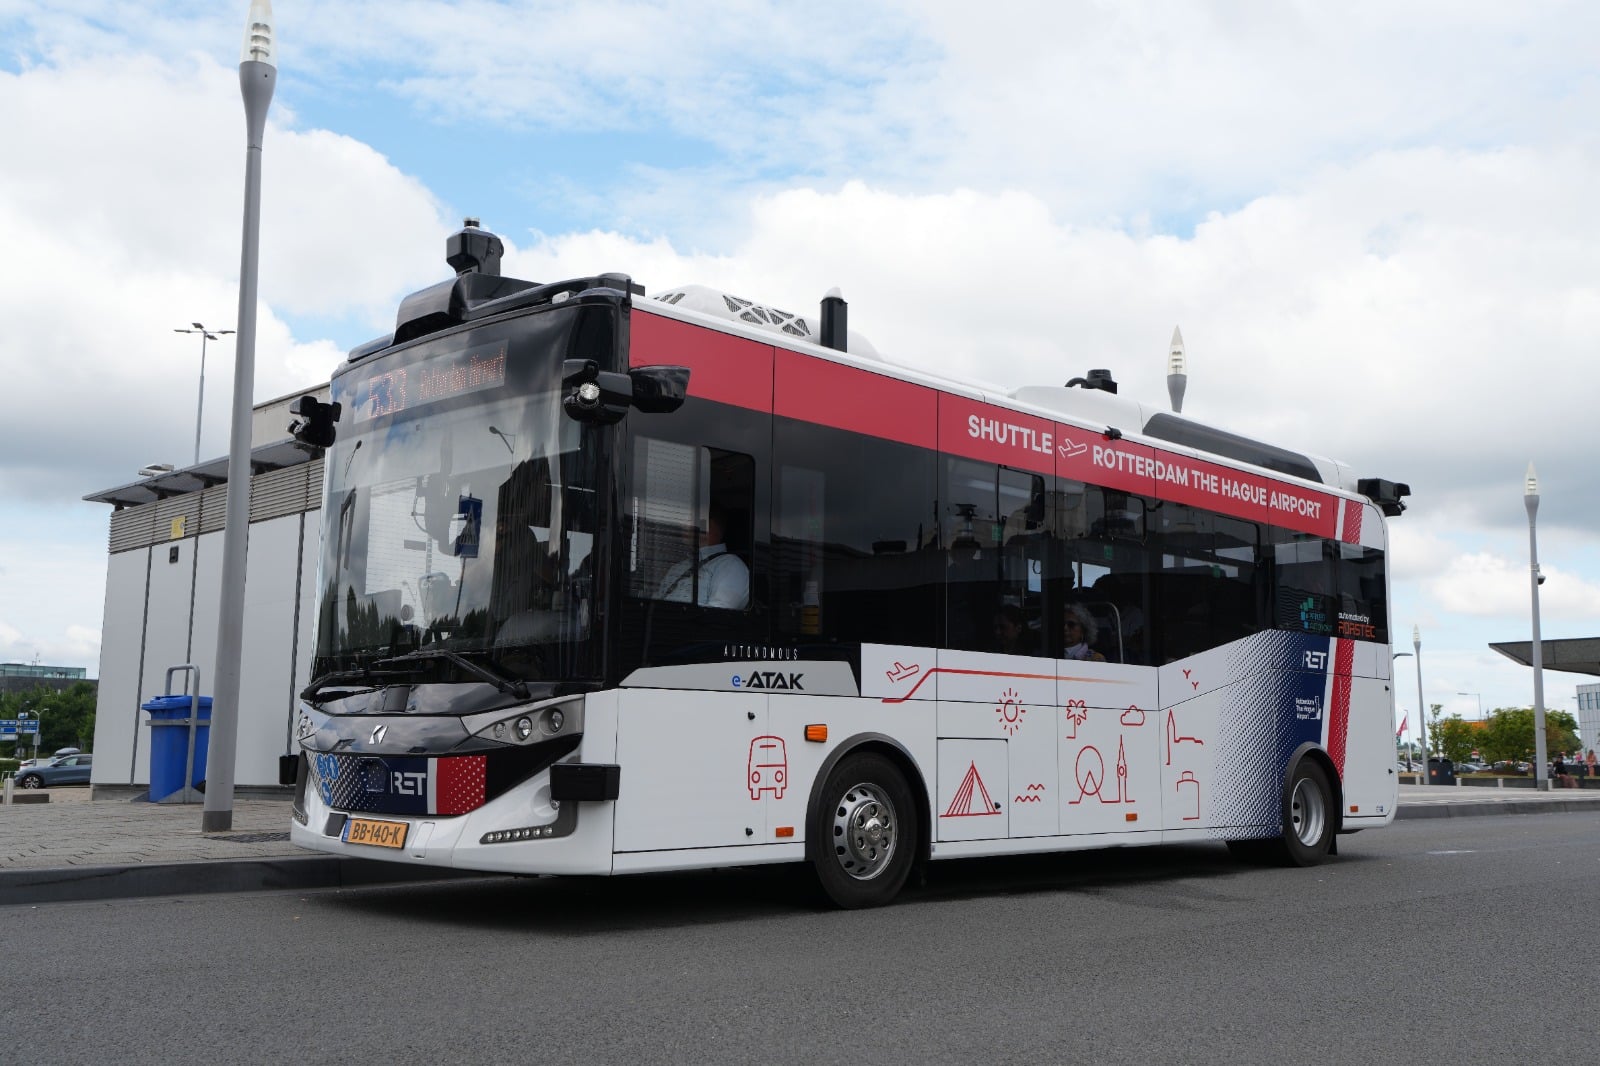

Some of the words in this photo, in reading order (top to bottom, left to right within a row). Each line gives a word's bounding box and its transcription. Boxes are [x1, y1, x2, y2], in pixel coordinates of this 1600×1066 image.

[968, 414, 1053, 455] SHUTTLE
[1093, 444, 1189, 487] ROTTERDAM
[1192, 469, 1219, 494] THE
[1221, 479, 1268, 506] HAGUE
[1269, 491, 1322, 519] AIRPORT
[723, 644, 798, 660] AUTONOMOUS
[1302, 649, 1327, 670] RET
[732, 670, 804, 690] e-ATAK
[390, 771, 427, 796] RET
[351, 822, 401, 845] BB-140-K
